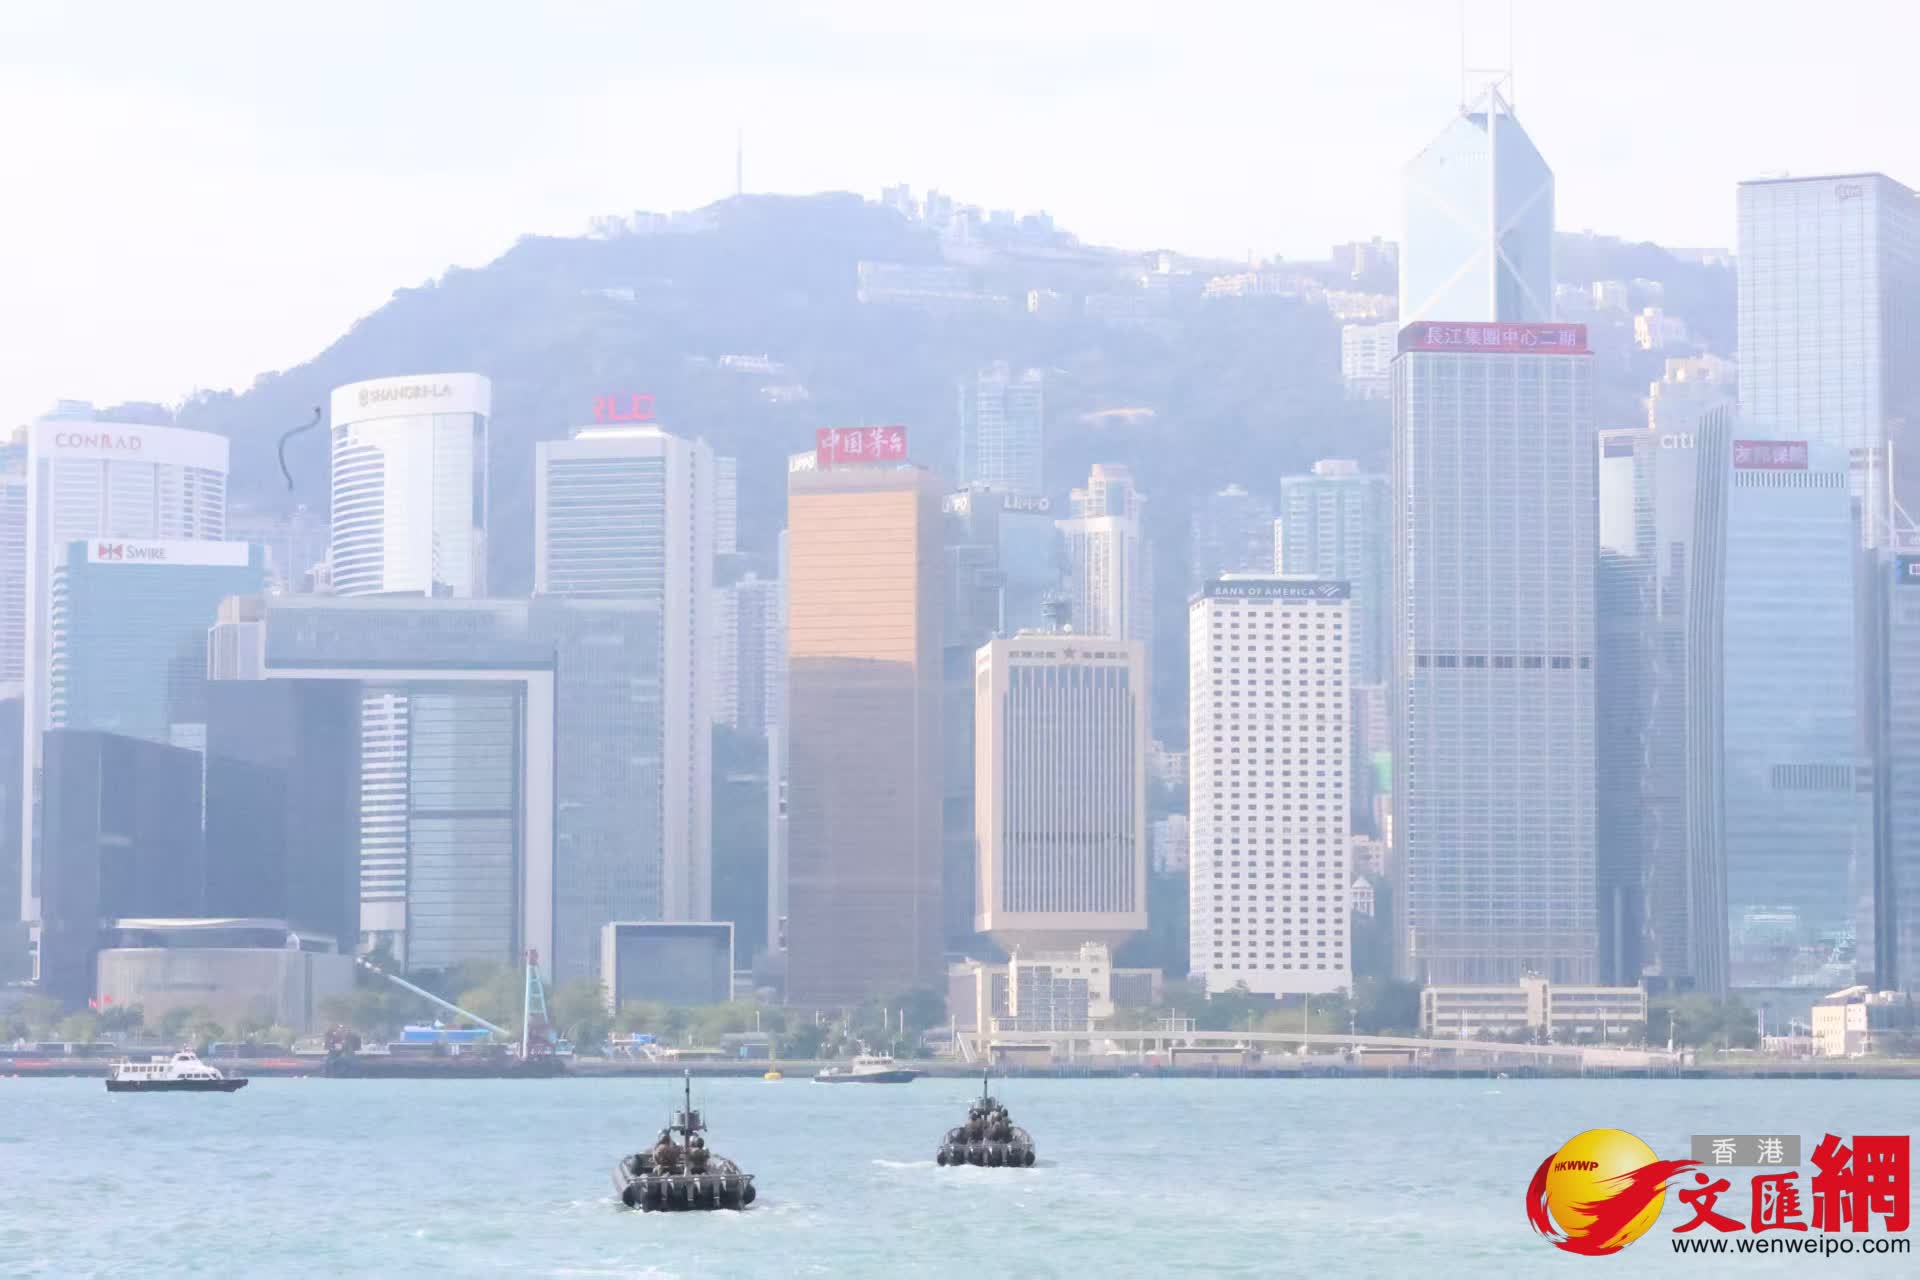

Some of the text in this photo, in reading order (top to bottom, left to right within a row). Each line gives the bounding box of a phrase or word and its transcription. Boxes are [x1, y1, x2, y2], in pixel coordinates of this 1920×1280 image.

[1426, 326, 1576, 346] 長江集團中心二期
[367, 384, 454, 402] SHANGRI-LA
[55, 431, 143, 450] CONRAD
[821, 427, 903, 459] 中国茅台
[1215, 586, 1315, 597] BANK OF AMERICA
